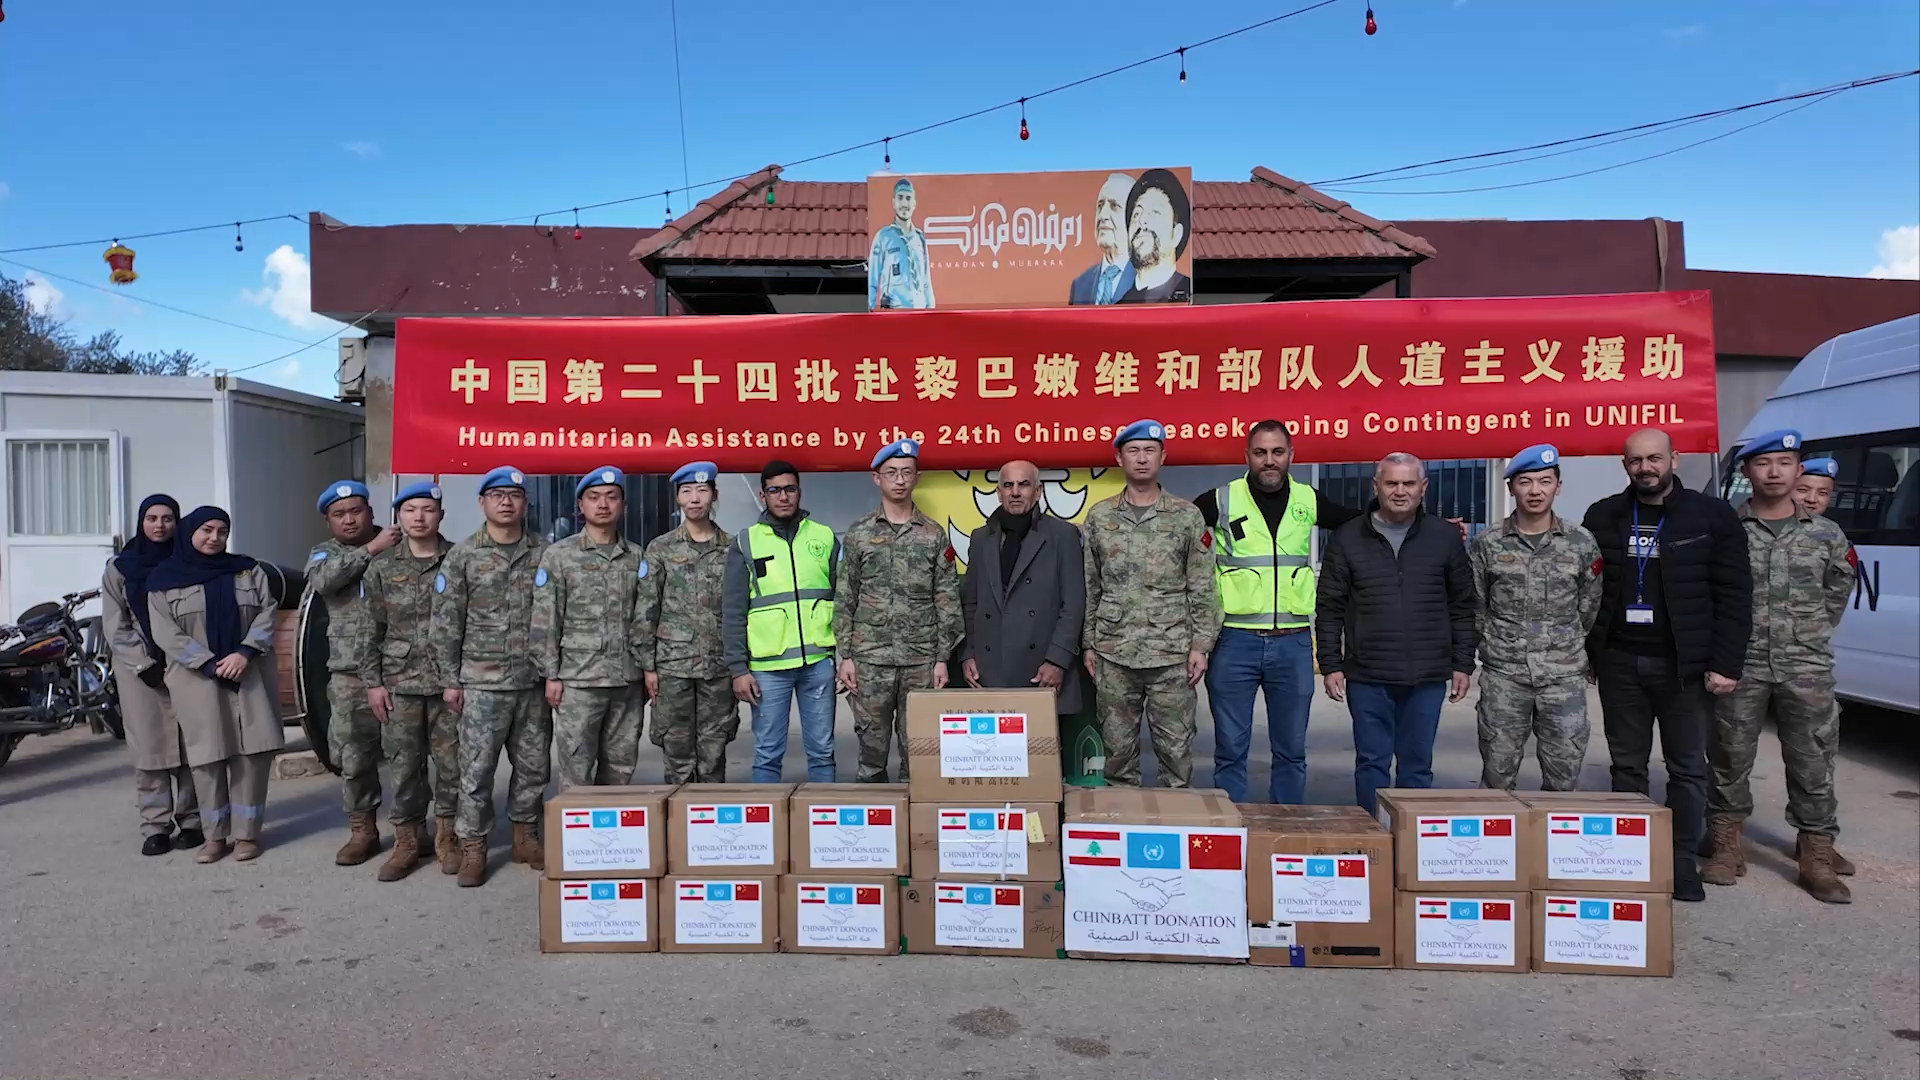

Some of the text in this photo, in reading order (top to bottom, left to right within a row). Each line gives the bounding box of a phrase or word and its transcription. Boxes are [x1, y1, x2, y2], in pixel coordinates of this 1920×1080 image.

[930, 261, 985, 269] RAMADAN
[450, 334, 1685, 404] 中国第二十四批赴黎巴嫩维和部队人道主义援助
[458, 426, 652, 448] Humanitarian
[665, 427, 821, 447] Assistance
[833, 427, 867, 450] by
[879, 426, 925, 446] the
[937, 424, 1001, 445] 24th
[1164, 414, 1349, 440] eacekping
[1363, 409, 1531, 434] Contingent
[1544, 408, 1571, 428] in
[1585, 404, 1684, 427] UNIFIL
[1854, 560, 1880, 612] N
[567, 847, 643, 857] CHINBATT DONATION
[730, 844, 768, 852] DONATION
[1553, 857, 1642, 866] CHINBATT DONATION
[1278, 898, 1362, 907] CHINBATT DONATION
[566, 920, 641, 928] CHINBATT DONATION
[1073, 910, 1237, 928] CHINBATT DONATION
[940, 924, 1017, 934] CHINBATT DONATION
[1087, 929, 1221, 947] هبة الكتيبة الصينية
[1421, 940, 1507, 950] CHINBATT DONATION
[1549, 940, 1639, 952] CHINBATT DONATION
